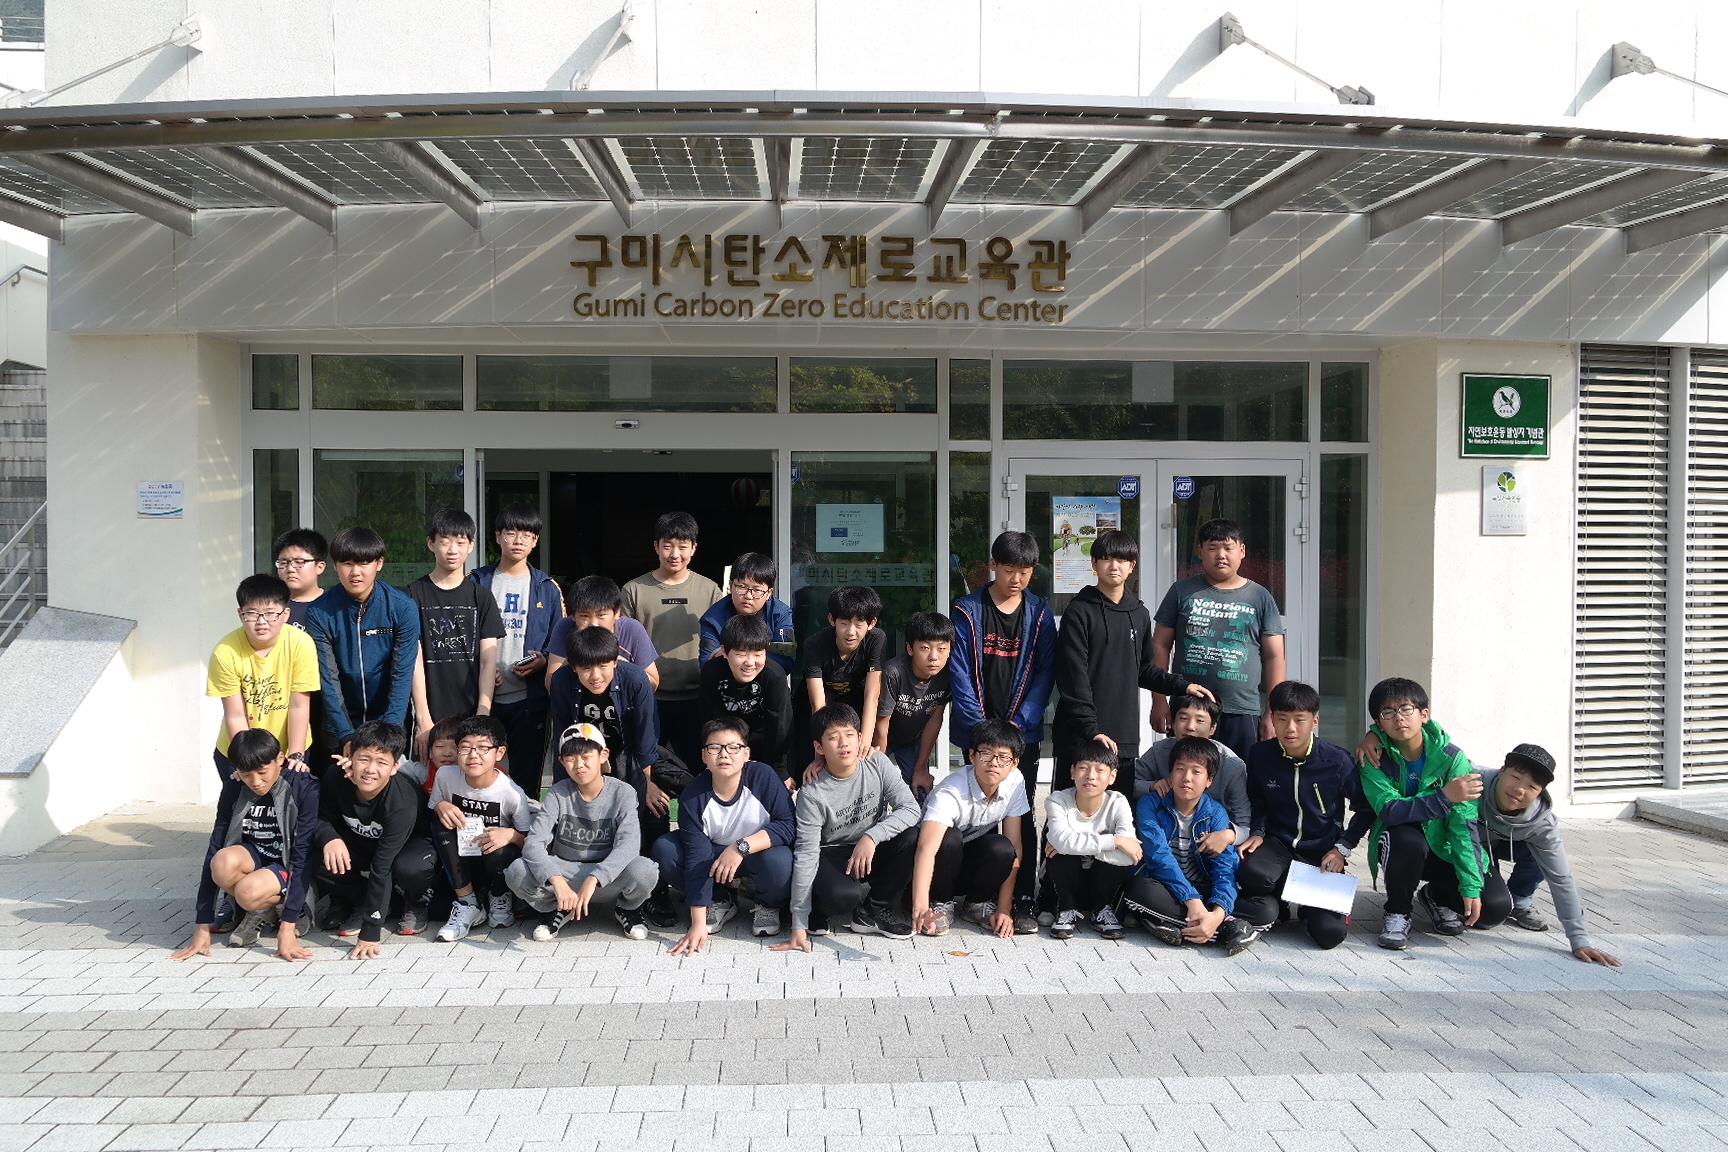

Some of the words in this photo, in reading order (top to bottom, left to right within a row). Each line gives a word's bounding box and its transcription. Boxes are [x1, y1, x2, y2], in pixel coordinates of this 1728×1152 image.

[570, 233, 1072, 293] 구미시탄소제로교육관
[573, 292, 646, 318] Gumi
[654, 291, 754, 318] Carbon
[763, 293, 825, 318] Zero
[834, 293, 970, 320] Education
[978, 296, 1069, 322] Center
[1121, 483, 1136, 491] ADT
[1176, 482, 1192, 491] ADT
[1190, 607, 1238, 619] Mutant
[1192, 598, 1256, 615] Notorious
[462, 799, 489, 811] STAY
[560, 820, 611, 842] R-CODE
